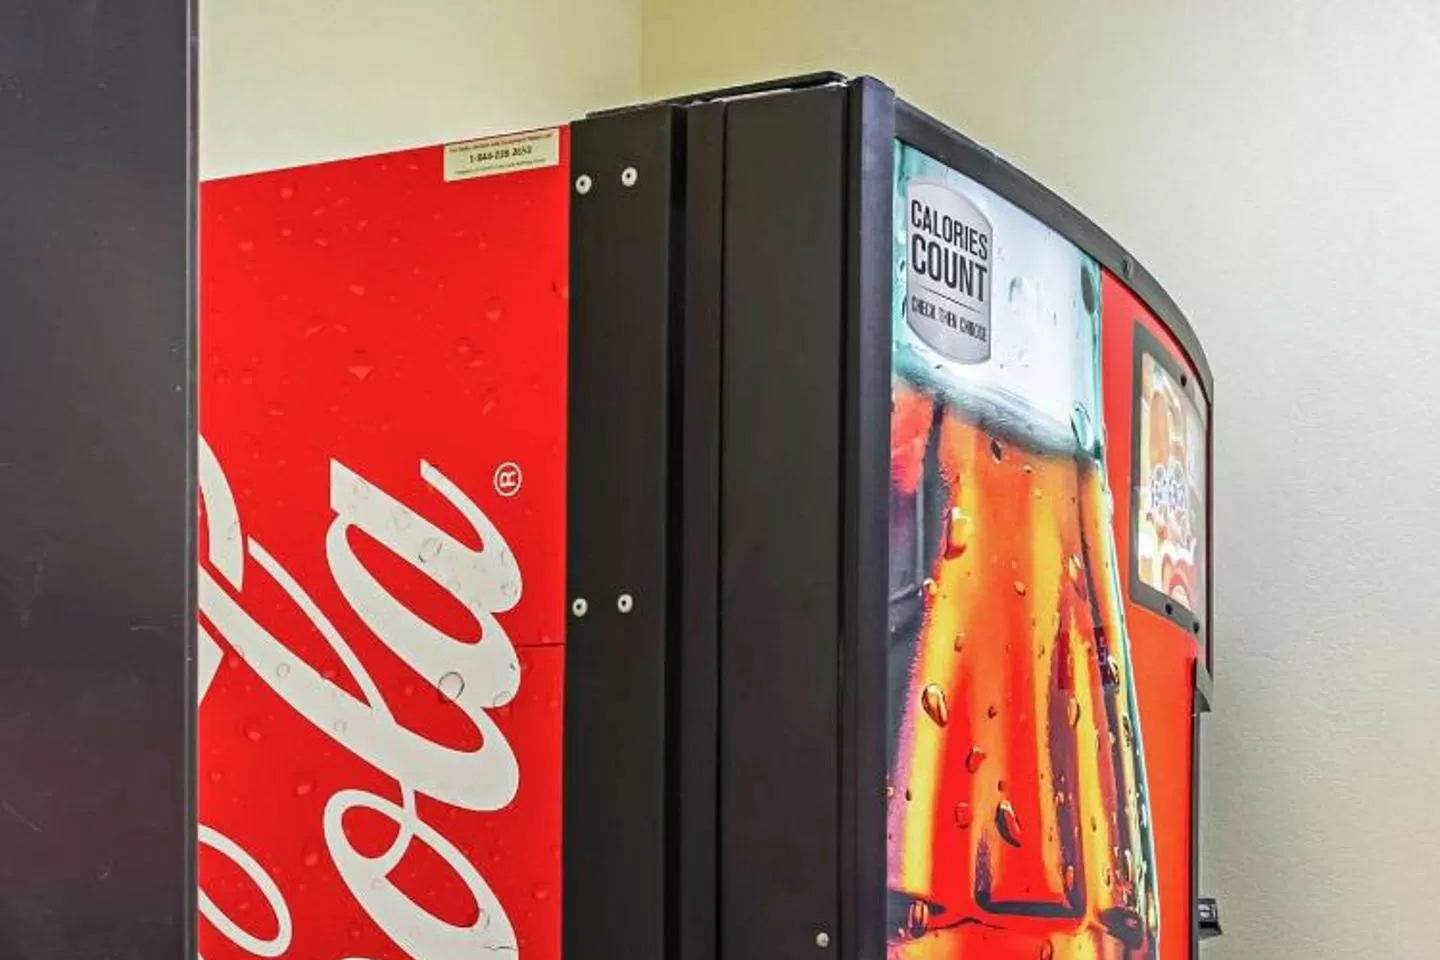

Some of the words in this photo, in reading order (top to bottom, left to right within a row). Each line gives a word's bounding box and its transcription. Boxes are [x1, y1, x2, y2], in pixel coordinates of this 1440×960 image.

[911, 199, 988, 261] CALORIES
[911, 234, 988, 302] COUNT
[912, 296, 935, 319] CHECK
